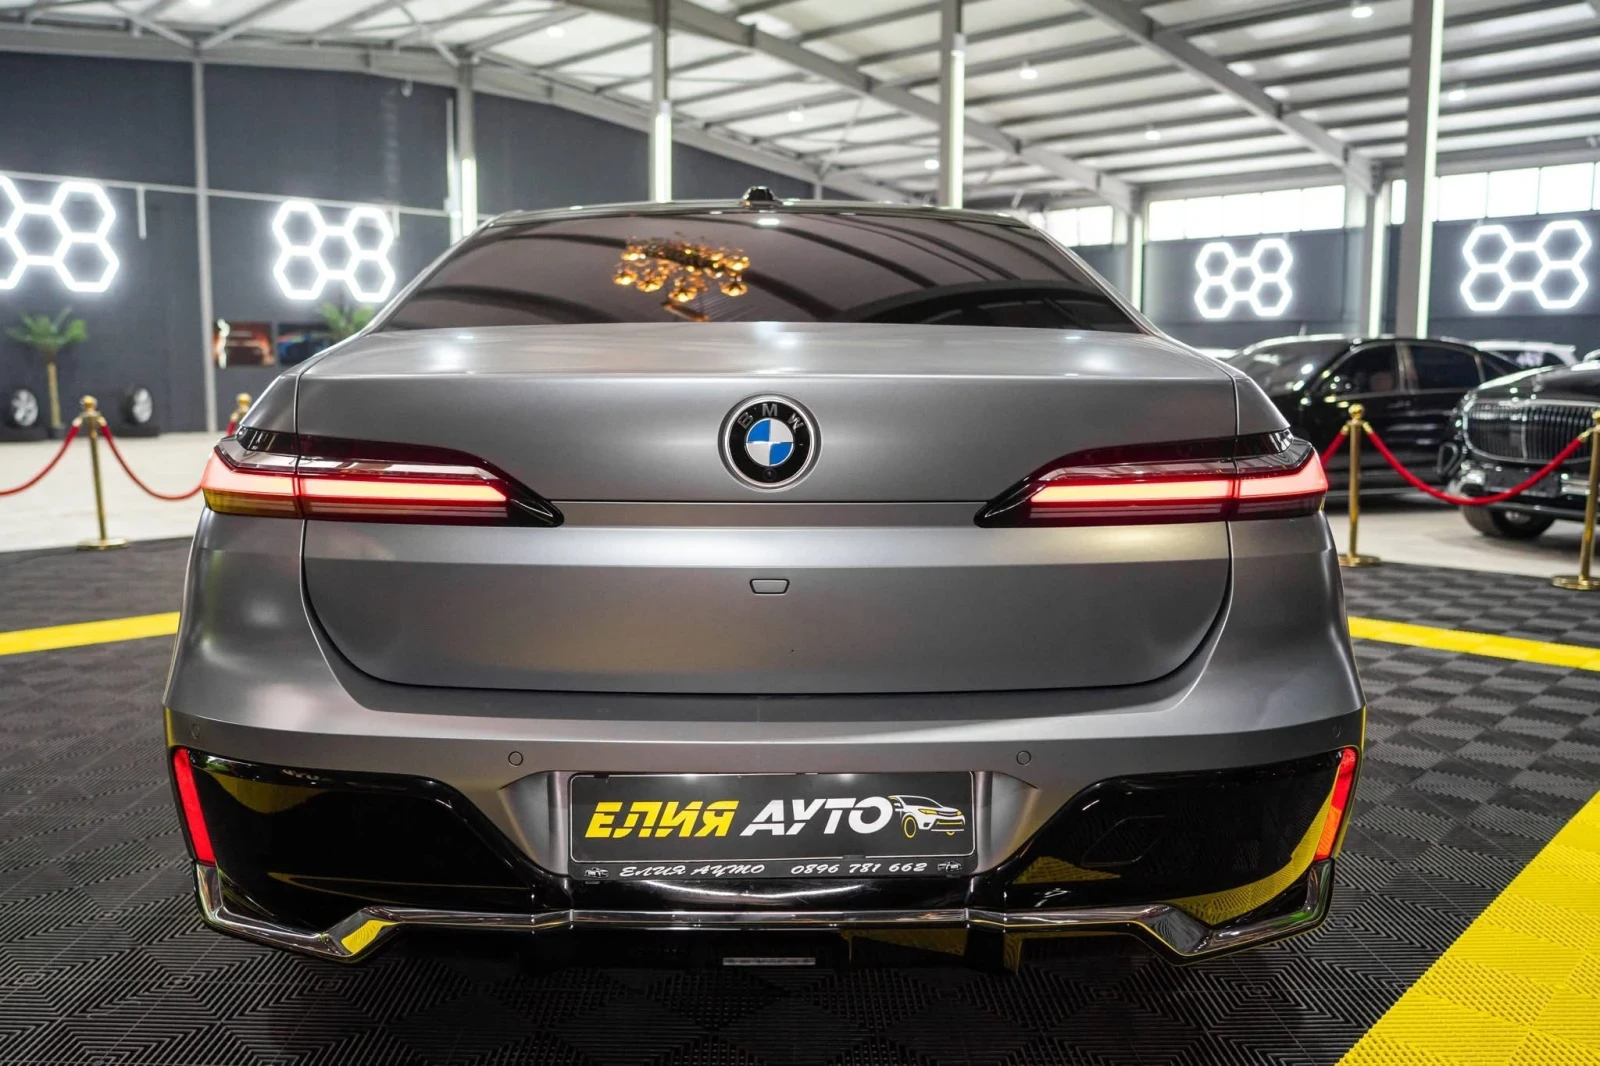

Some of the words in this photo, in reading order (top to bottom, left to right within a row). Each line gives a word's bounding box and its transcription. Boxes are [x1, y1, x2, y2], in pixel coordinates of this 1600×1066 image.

[737, 403, 804, 432] BMW
[585, 800, 740, 839] ЕЛИЯ
[740, 796, 893, 836] АУТО
[790, 863, 840, 875] 0896
[849, 862, 880, 874] 781
[888, 862, 927, 873] 662
